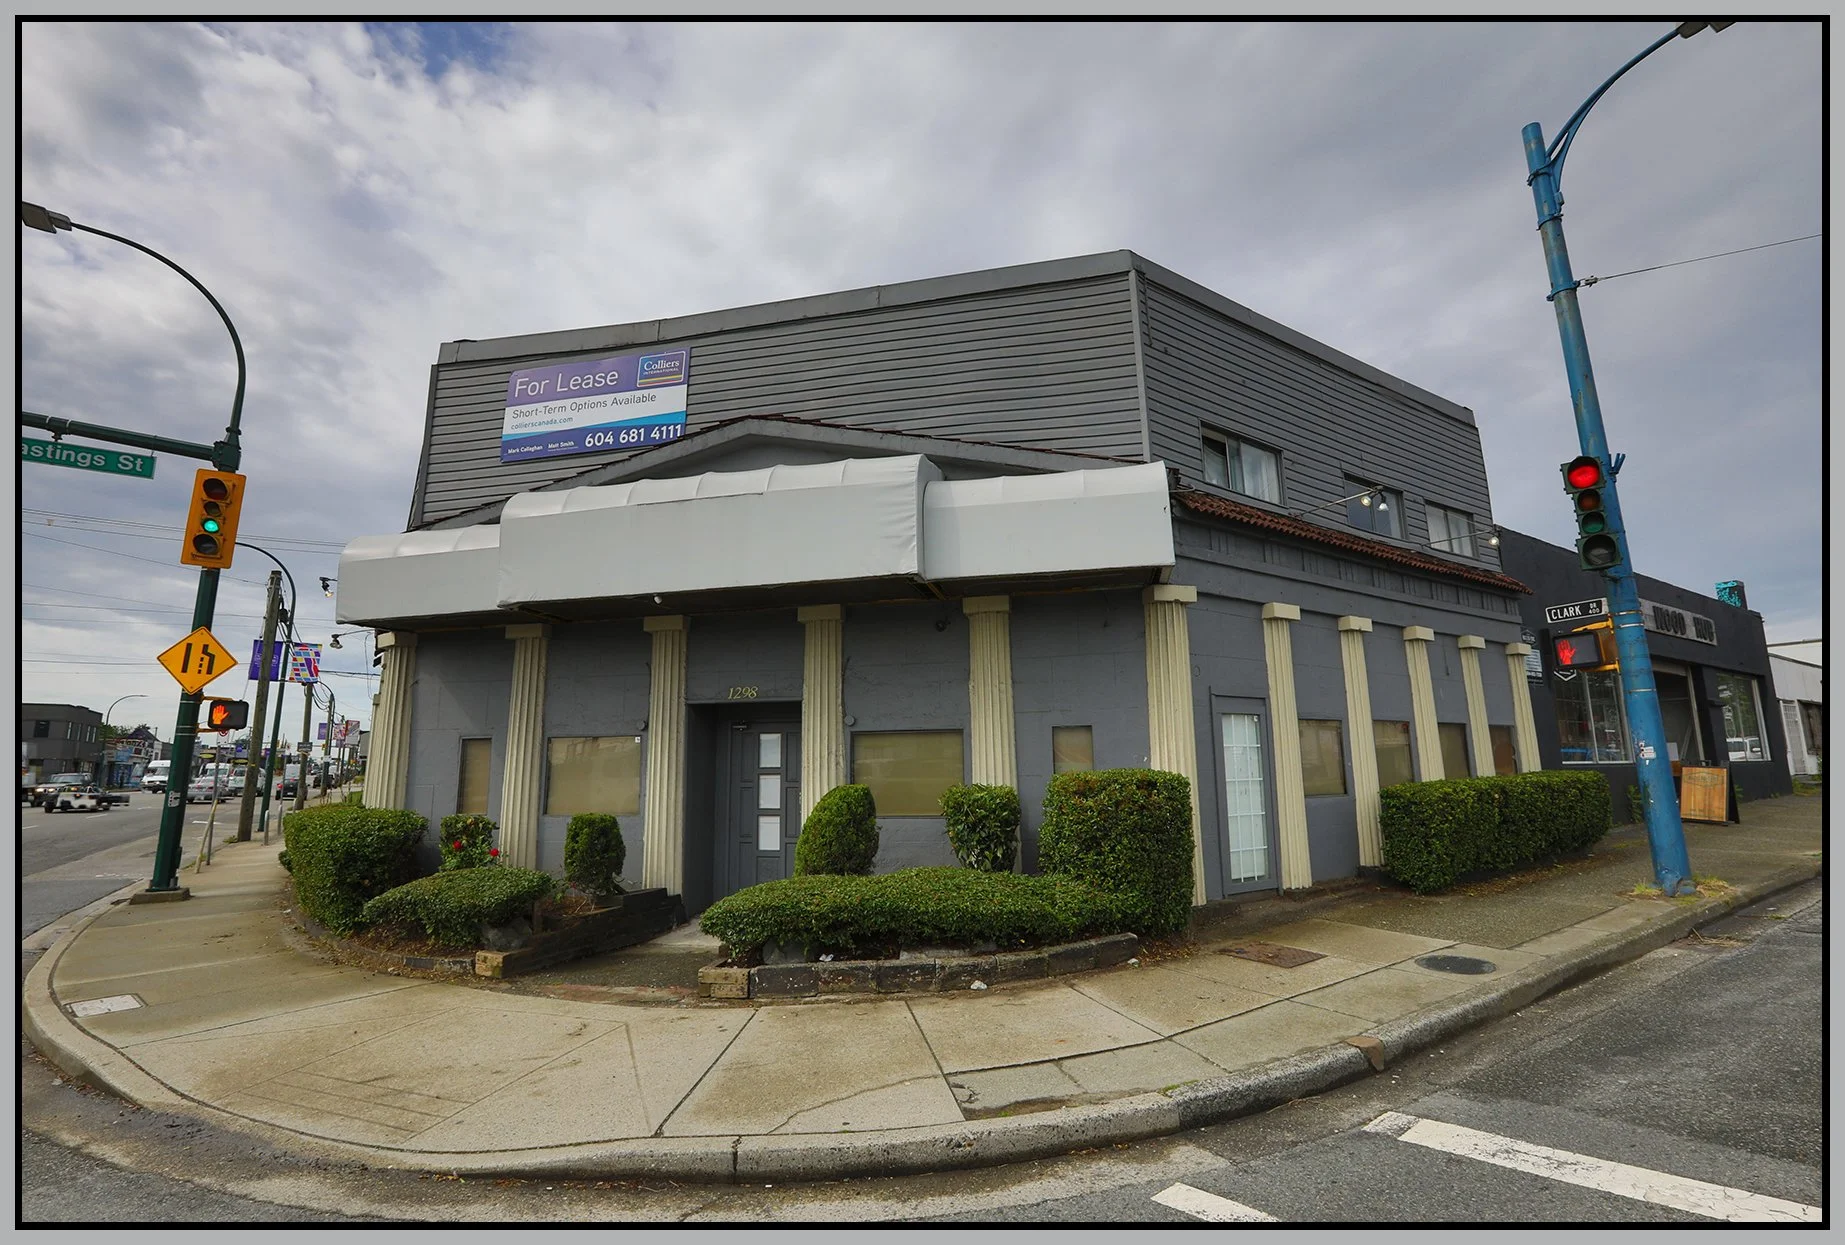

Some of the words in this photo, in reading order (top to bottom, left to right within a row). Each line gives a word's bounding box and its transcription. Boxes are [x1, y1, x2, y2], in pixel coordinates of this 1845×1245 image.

[644, 360, 680, 371] Colliers
[514, 377, 550, 398] For
[556, 371, 619, 393] Lease
[512, 405, 566, 419] Short-Term
[570, 400, 608, 413] Options
[611, 393, 656, 406] Available
[511, 416, 574, 431] collierscanada.com
[585, 432, 614, 448] 604
[619, 428, 645, 443] 681
[650, 424, 683, 441] 4111
[117, 454, 144, 472] St
[1551, 605, 1582, 620] CLARK
[1652, 605, 1687, 636] WOOD
[728, 686, 759, 700] 1298
